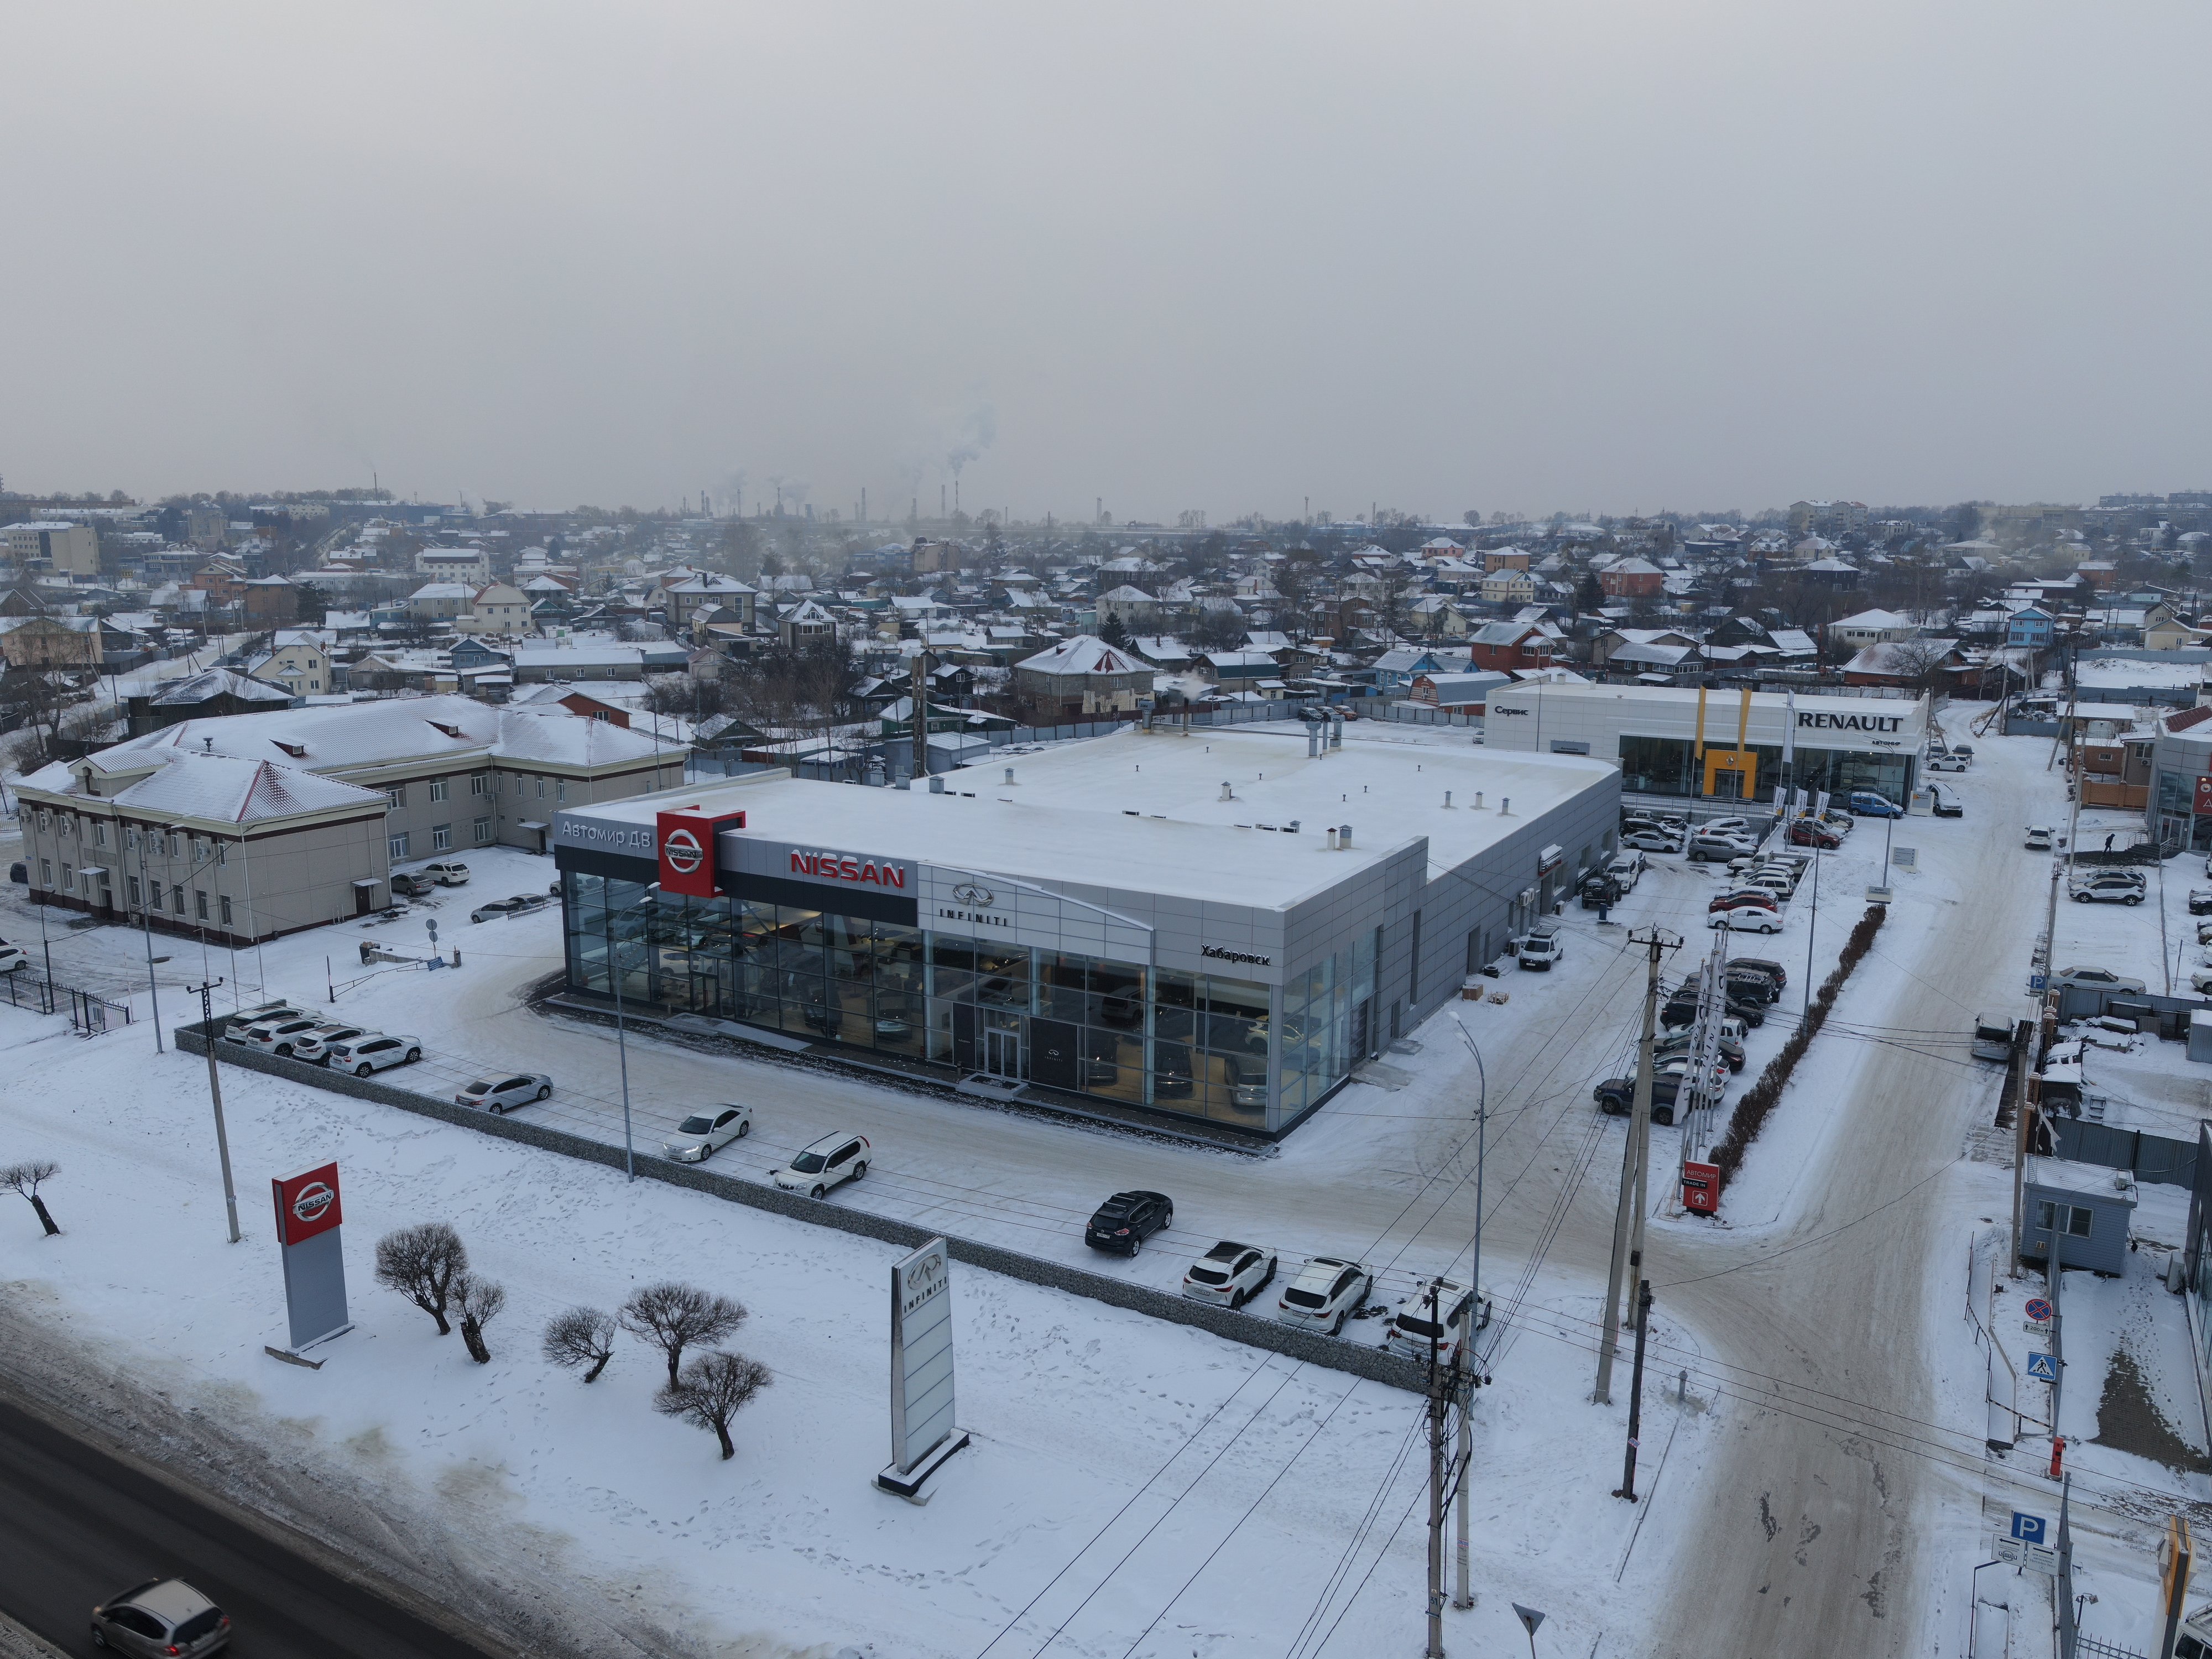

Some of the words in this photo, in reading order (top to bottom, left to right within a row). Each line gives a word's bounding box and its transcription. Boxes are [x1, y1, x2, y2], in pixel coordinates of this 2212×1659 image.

[1495, 706, 1528, 716] Сервис
[1799, 712, 1903, 732] RENAULT
[562, 821, 625, 846] Автомир
[629, 831, 651, 848] ДВ
[666, 848, 696, 858] NISSAN
[791, 850, 904, 888] NISSAN
[940, 909, 1007, 926] INFINITI
[1201, 943, 1270, 966] Хабаровск
[1686, 1170, 1717, 1180] АВТОМИР
[298, 1193, 332, 1212] NISSAN
[904, 1276, 947, 1313] INFINITI
[2019, 1516, 2039, 1537] P
[1430, 1596, 1438, 1605] 31
